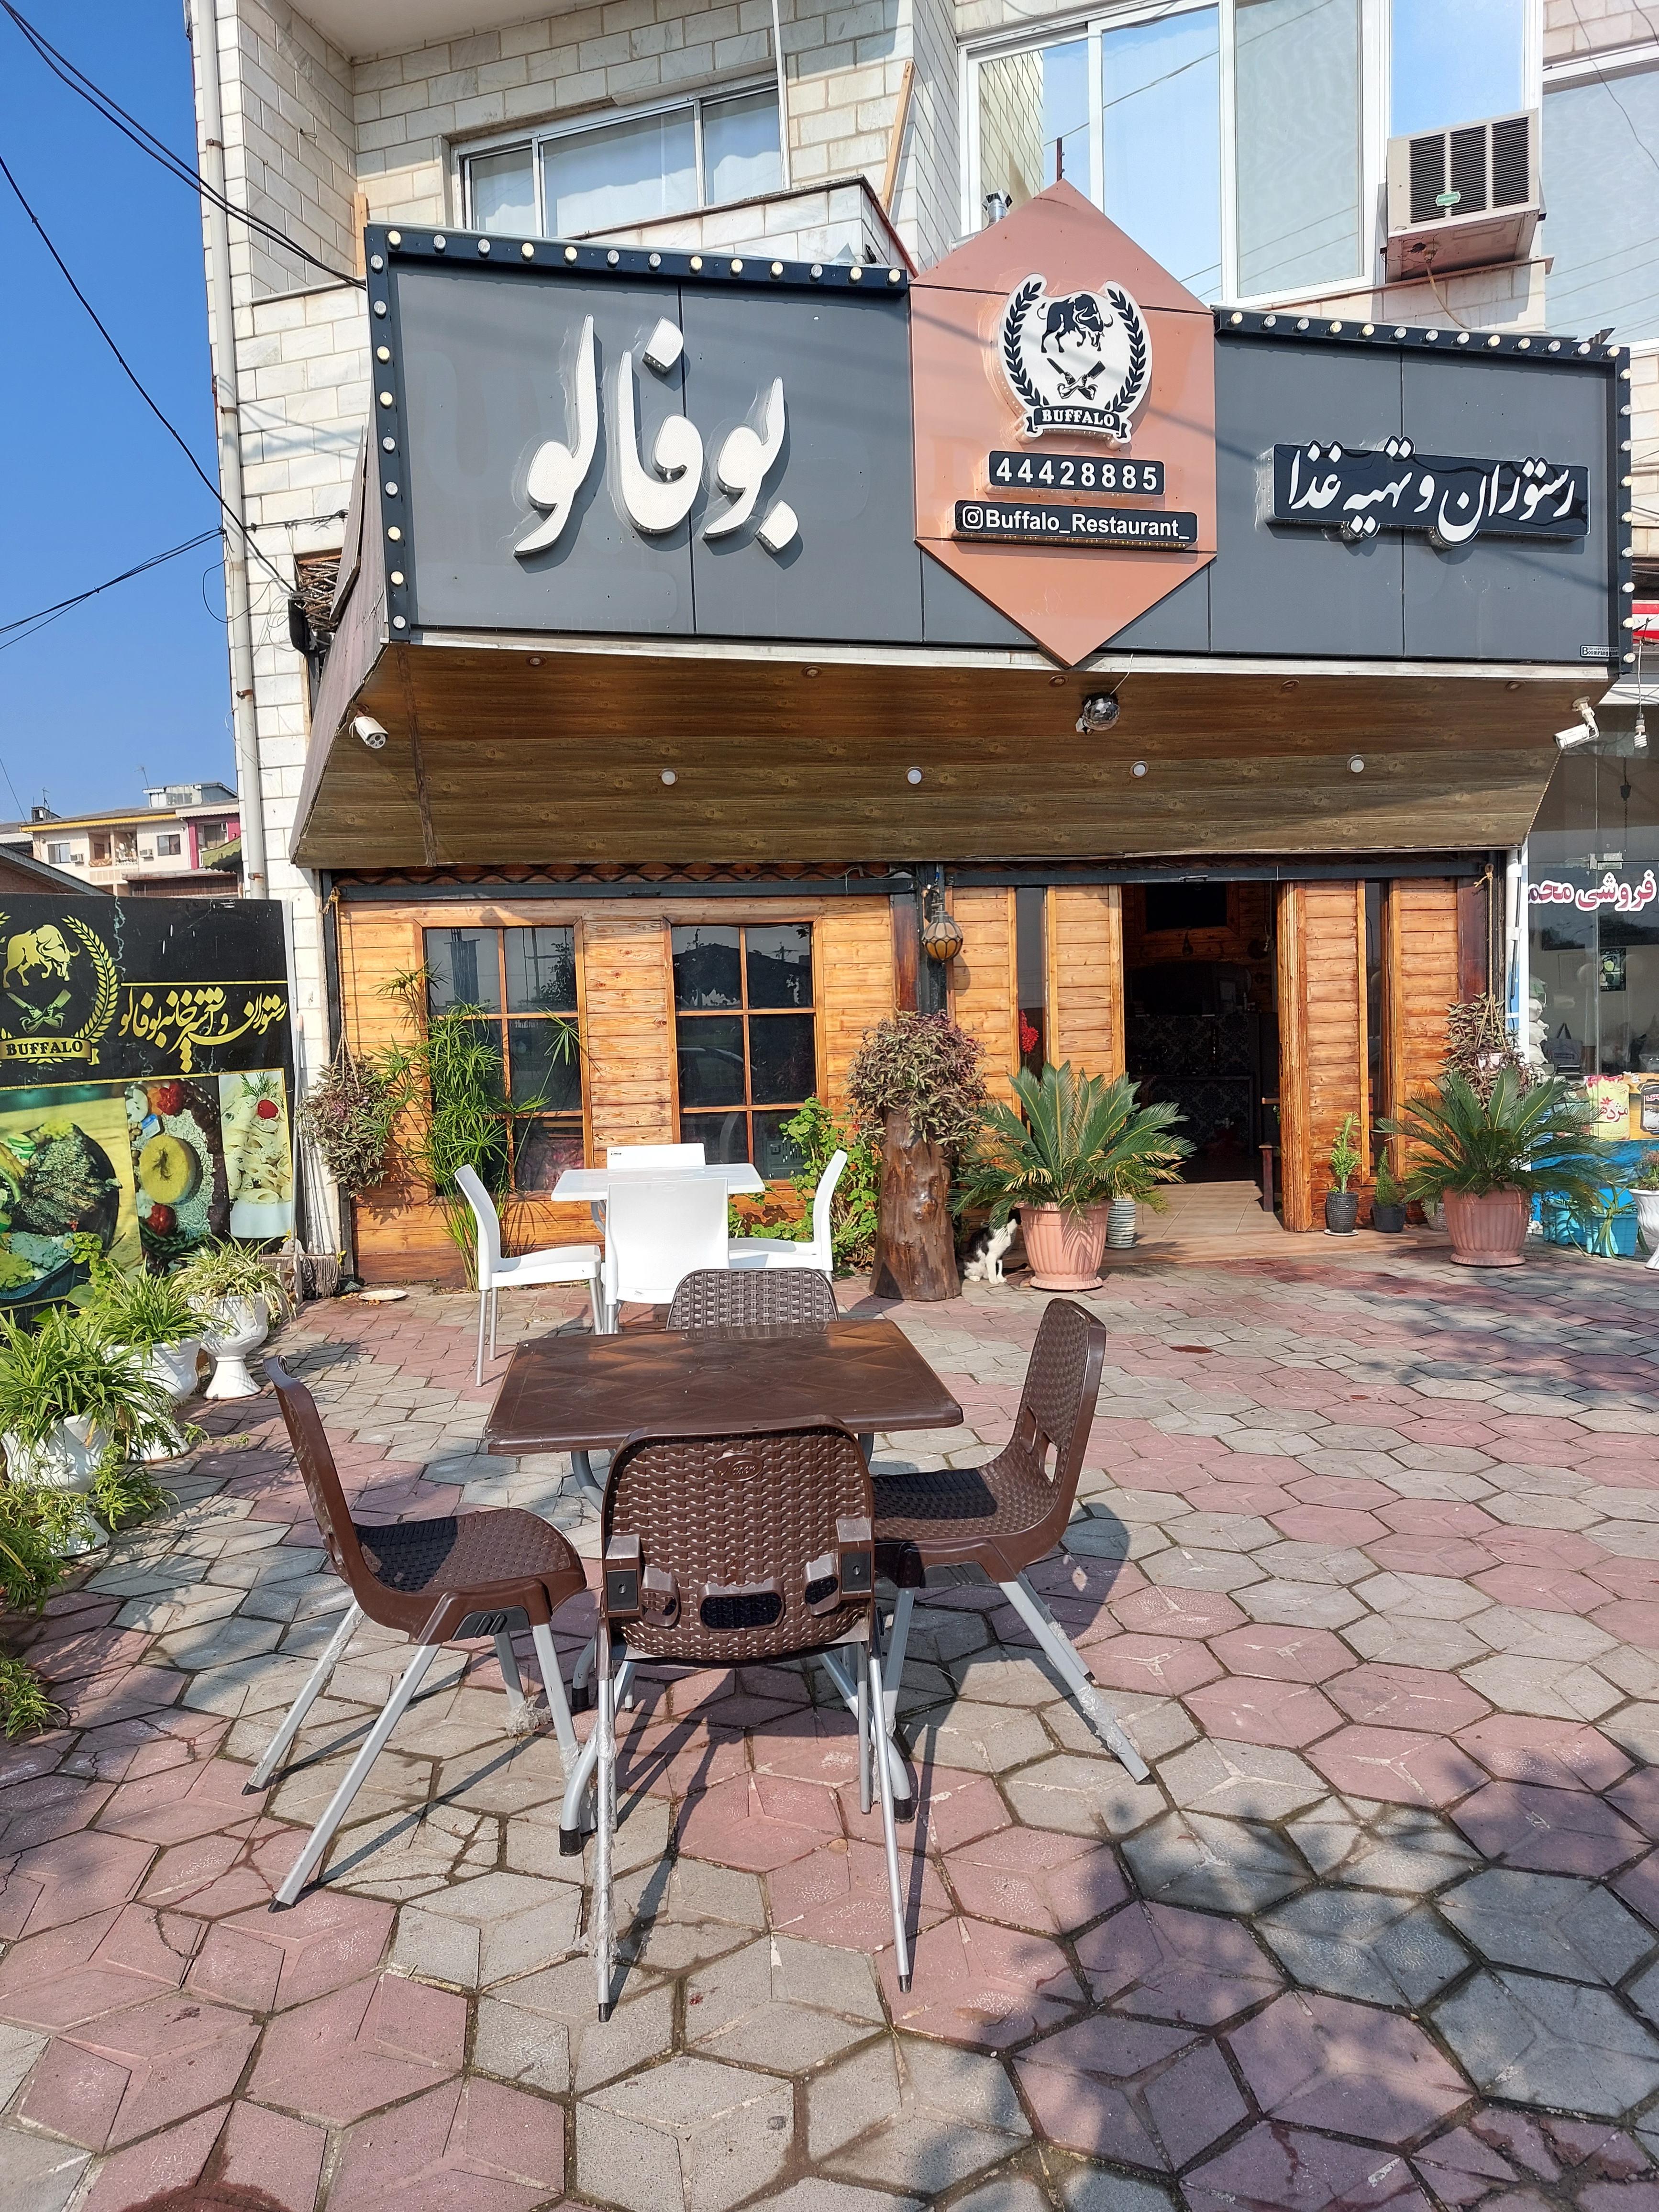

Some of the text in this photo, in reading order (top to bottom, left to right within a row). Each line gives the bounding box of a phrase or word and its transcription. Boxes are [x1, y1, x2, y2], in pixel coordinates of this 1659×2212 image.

[514, 314, 799, 557] بوفالو
[1041, 408, 1115, 427] BUFFALO
[995, 456, 1157, 491] 44428885
[1288, 436, 1575, 542] رستوران و تهیه غذا
[986, 509, 1190, 540] Buffalo_Restaurant_
[1528, 871, 1657, 911] فروشی محم
[118, 986, 167, 1048] بوفالو
[5, 1040, 83, 1056] BUFFALO
